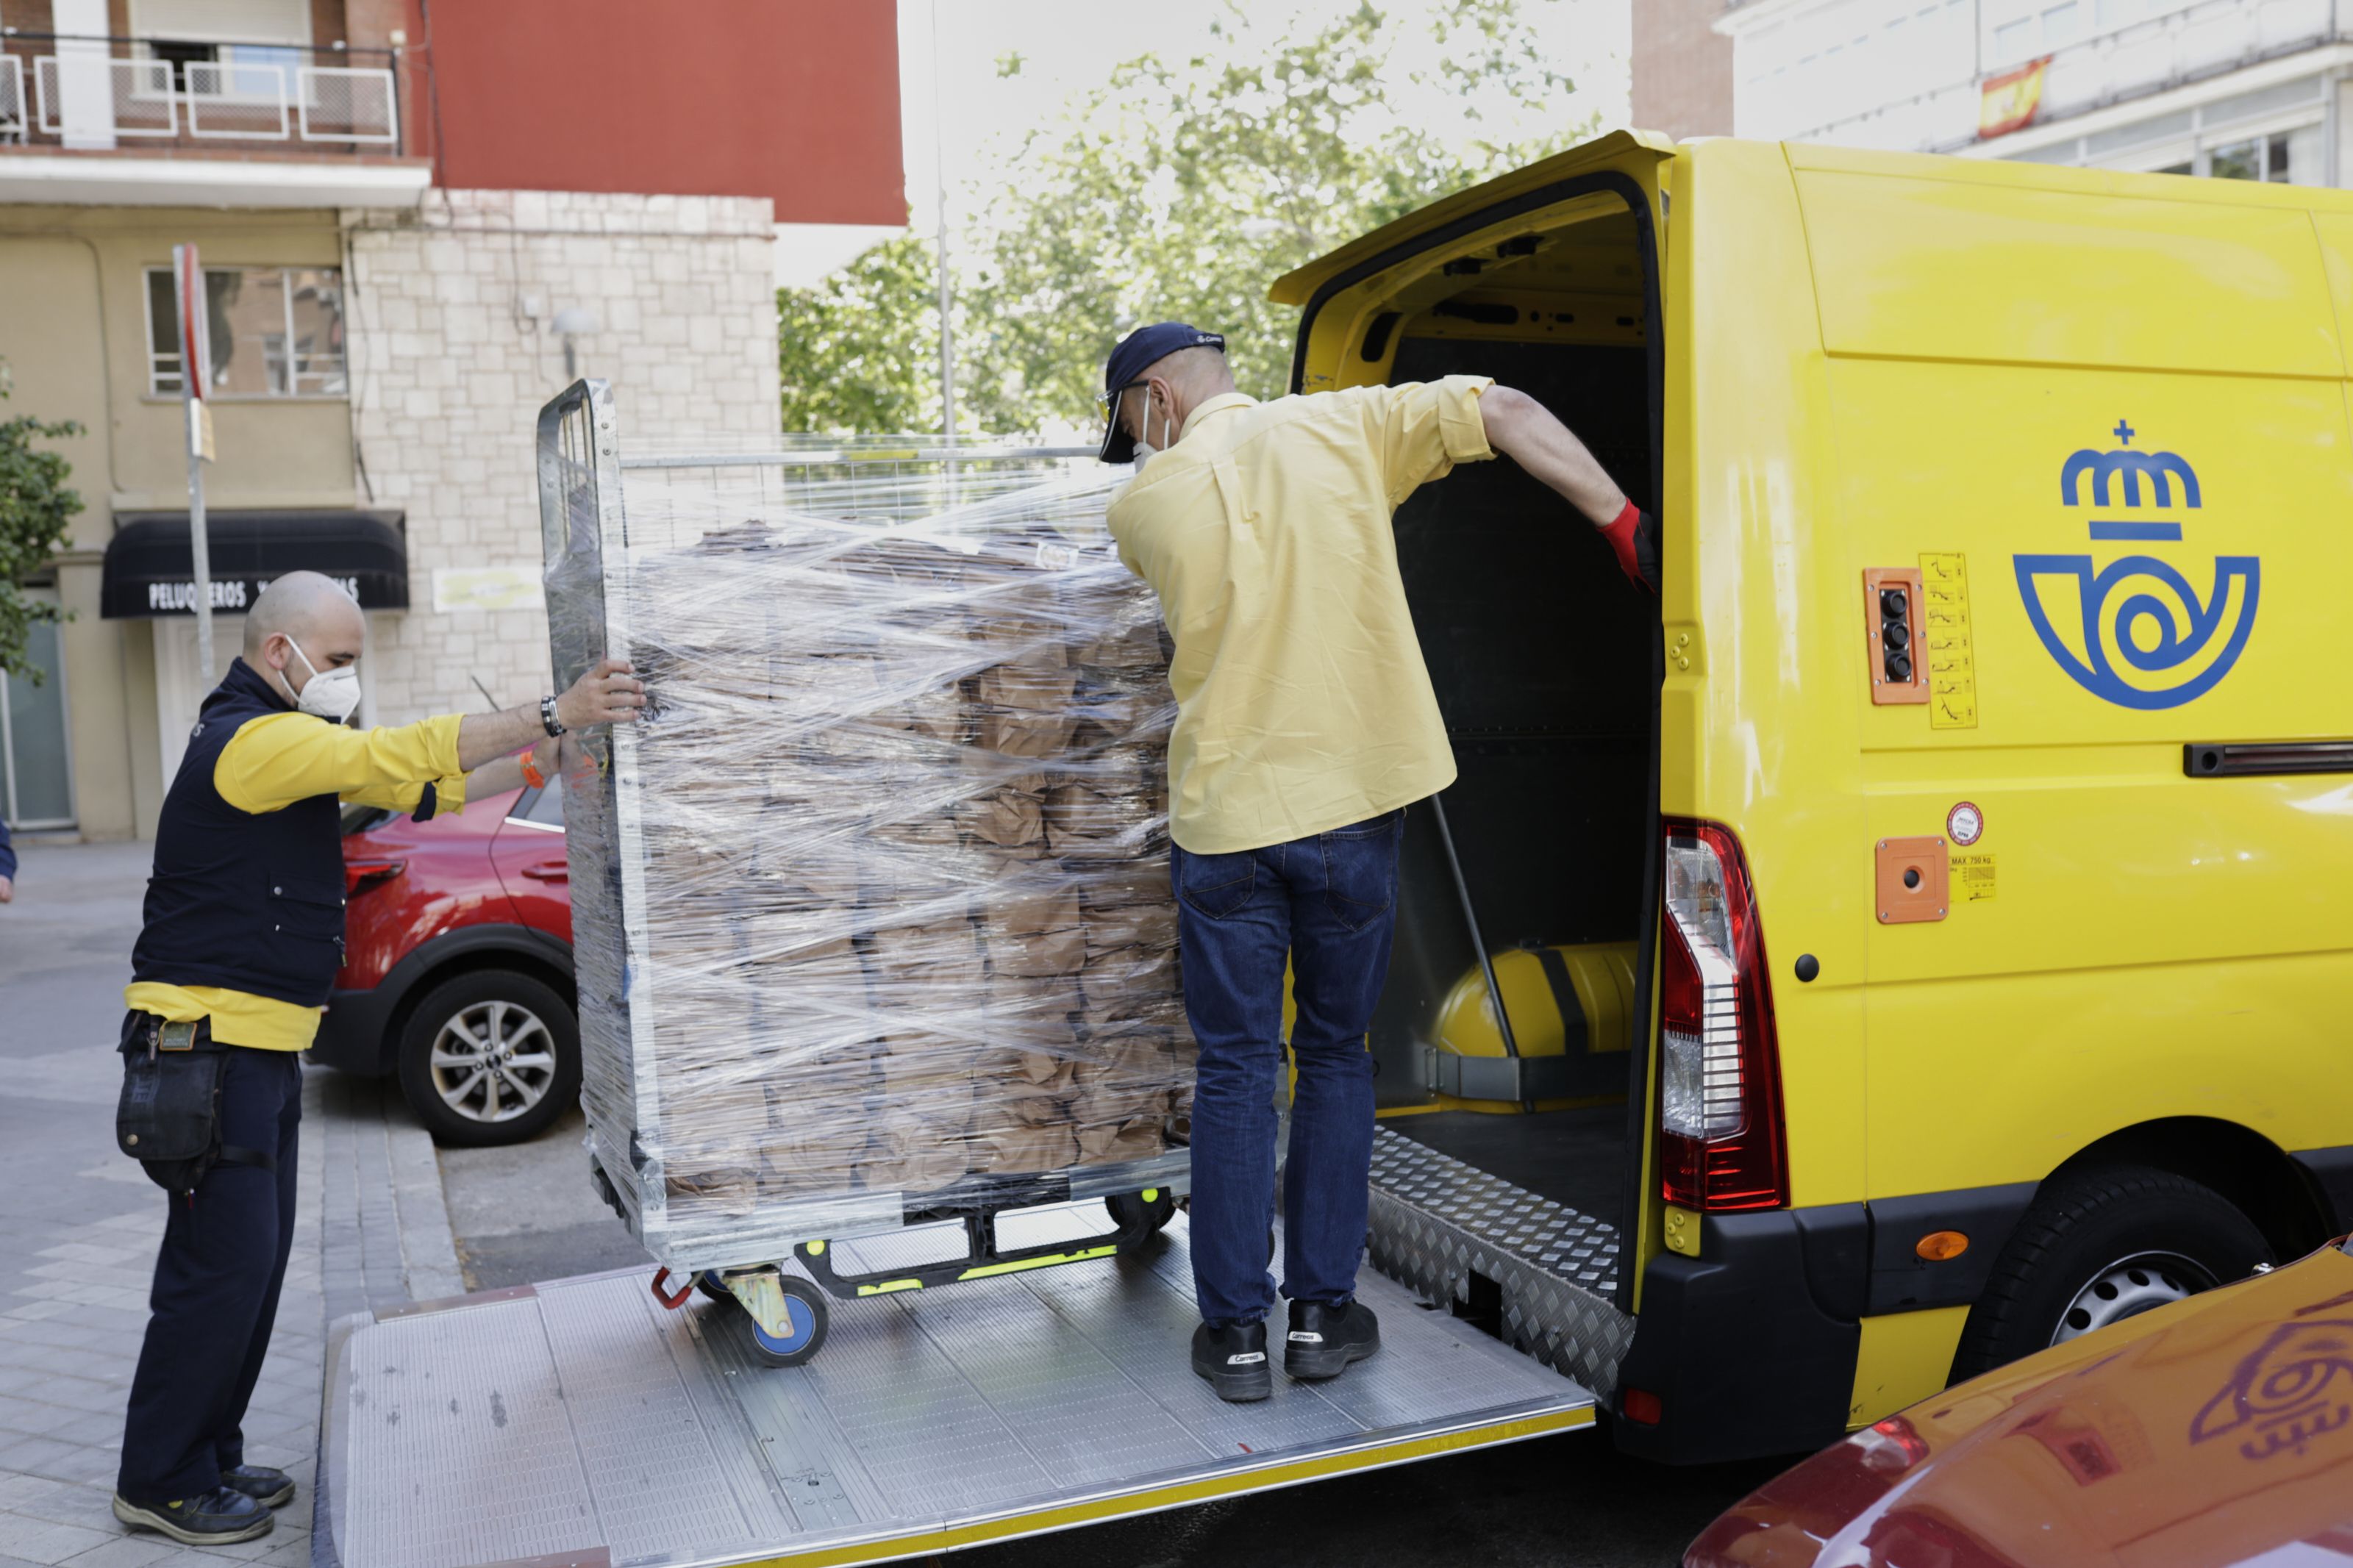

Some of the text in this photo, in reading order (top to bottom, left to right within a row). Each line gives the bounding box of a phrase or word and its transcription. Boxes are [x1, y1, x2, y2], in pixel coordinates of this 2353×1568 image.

[149, 581, 246, 613] PELUQEROS
[1971, 856, 1982, 864] 750
[1291, 1332, 1315, 1340] Correos
[1235, 1354, 1259, 1362] Correos
